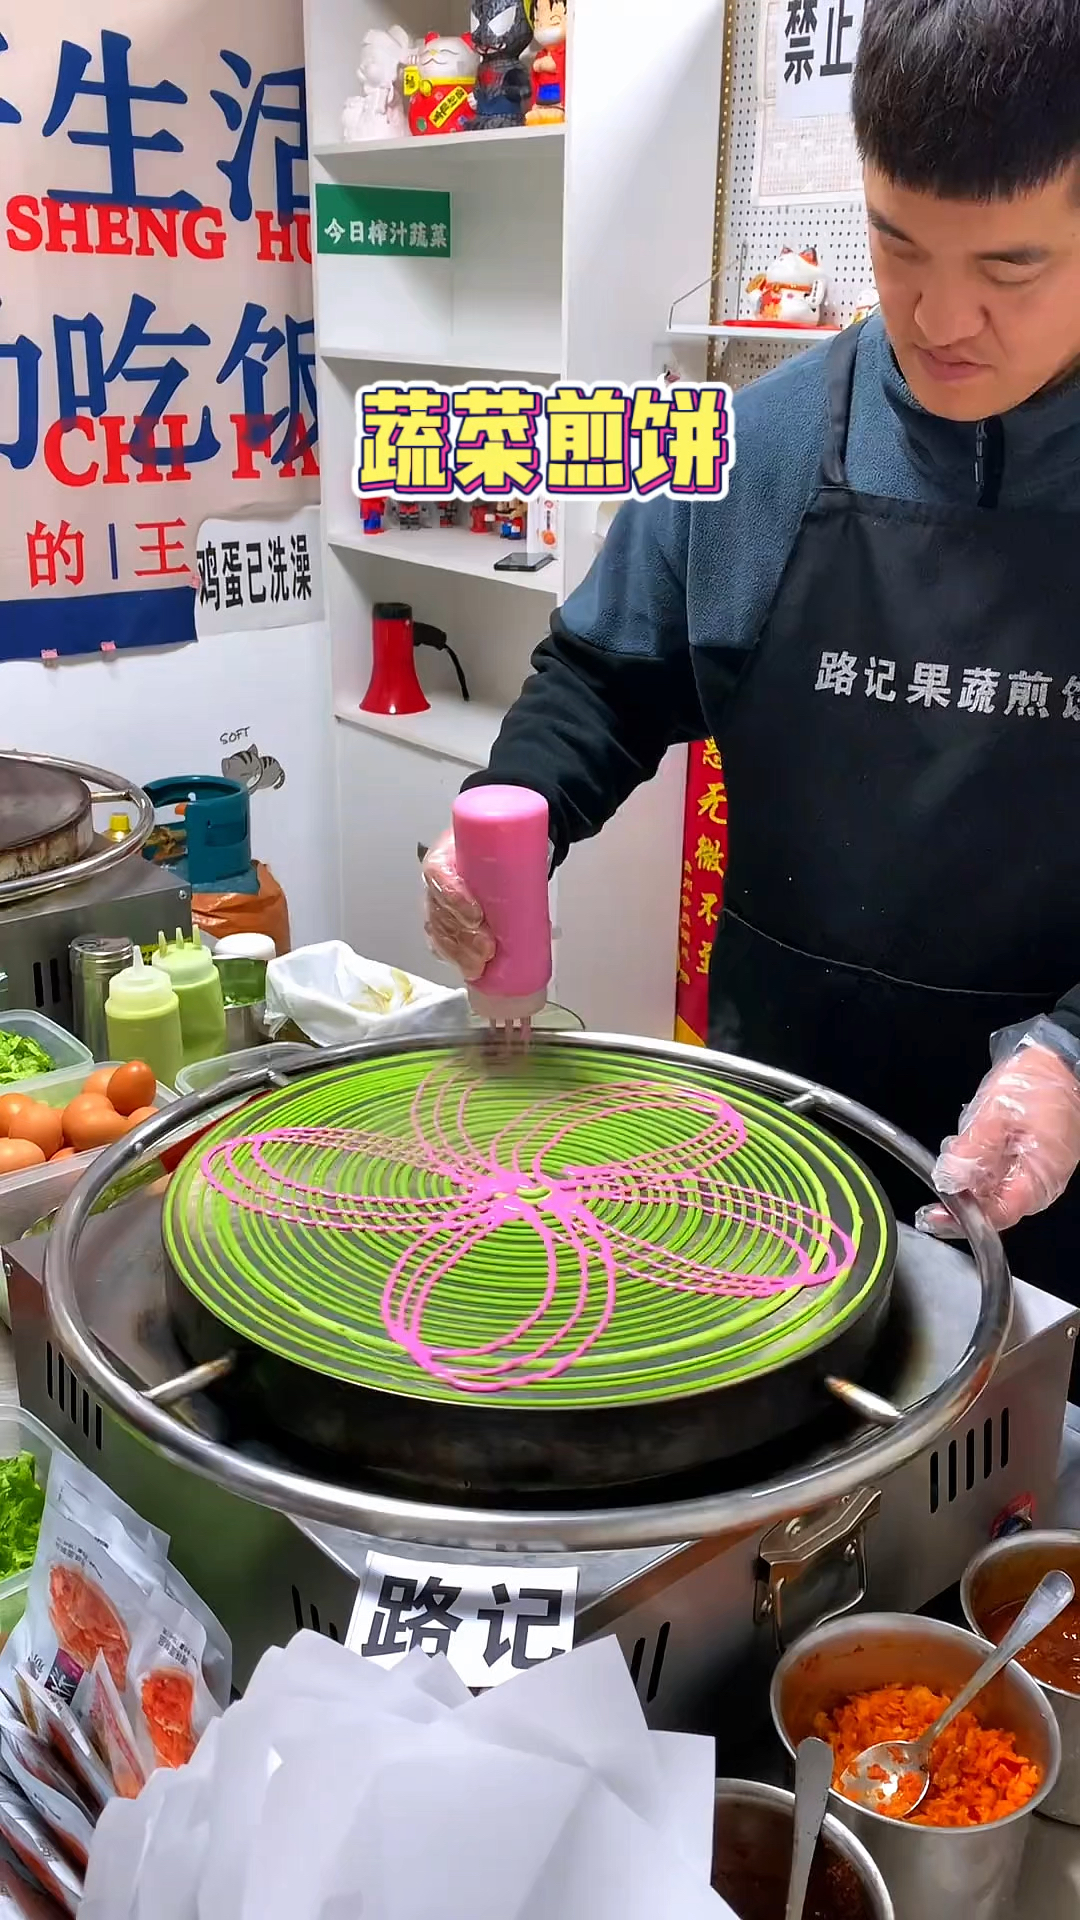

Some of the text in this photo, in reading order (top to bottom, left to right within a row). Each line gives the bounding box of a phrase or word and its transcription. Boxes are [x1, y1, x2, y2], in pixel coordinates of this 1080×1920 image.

[784, 0, 854, 85] 禁止
[0, 29, 310, 222] 生活
[6, 195, 227, 260] SHENG
[324, 217, 448, 248] 今日榨汁蔬菜
[0, 293, 318, 470] 吃饭
[44, 414, 192, 487] CHI
[196, 534, 312, 611] 鸡蛋已洗澡
[220, 726, 251, 745] SOFT
[361, 1575, 566, 1669] 路记
